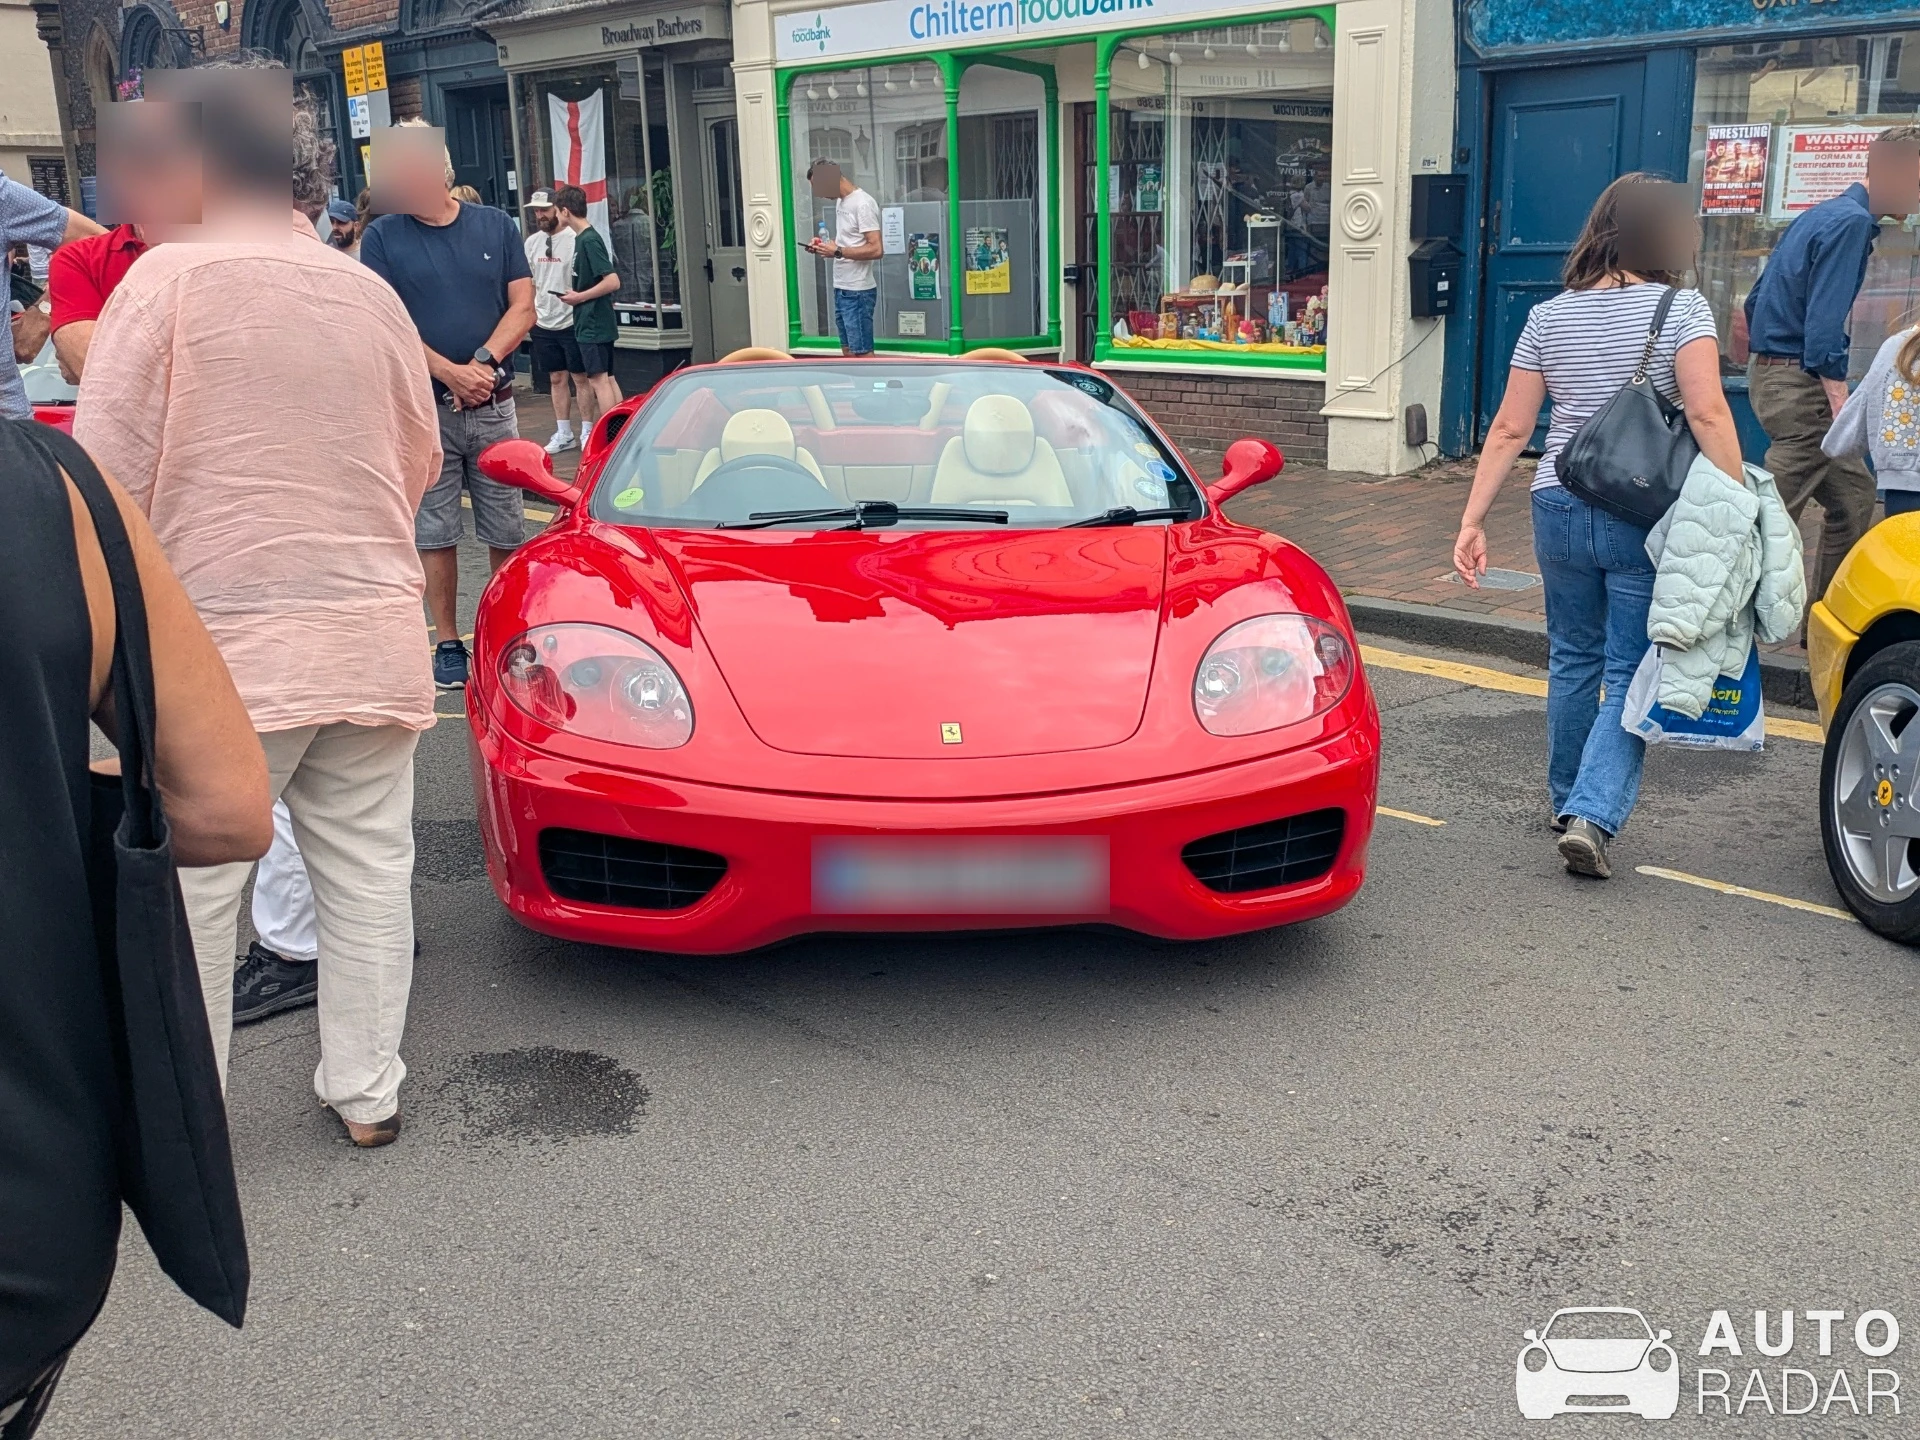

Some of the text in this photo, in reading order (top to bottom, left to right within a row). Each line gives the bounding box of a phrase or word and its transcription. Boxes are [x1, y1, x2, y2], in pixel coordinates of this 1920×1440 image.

[910, 0, 1153, 39] Chiltern foodba
[601, 16, 702, 45] Broadway Barbers
[792, 26, 831, 43] foodbank
[1709, 126, 1768, 139] WRESTLING
[1805, 134, 1879, 144] WARNIN
[1711, 687, 1742, 704] tory
[1668, 736, 1717, 744] cardfactory.co.uk
